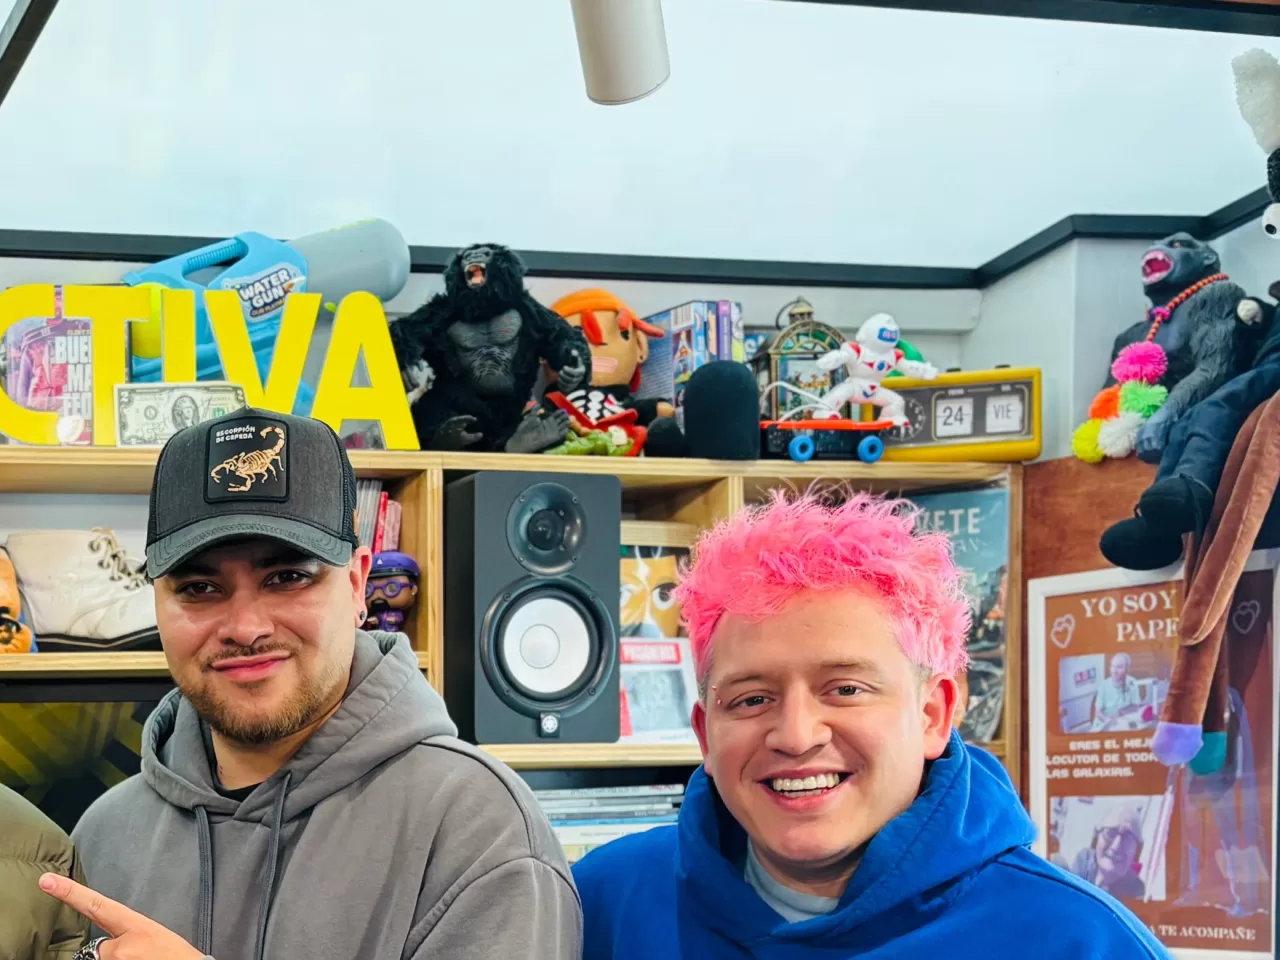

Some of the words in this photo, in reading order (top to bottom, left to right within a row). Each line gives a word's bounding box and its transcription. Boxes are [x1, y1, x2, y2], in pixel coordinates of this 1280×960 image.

[239, 268, 290, 301] WATER
[251, 284, 285, 309] GUN
[942, 405, 965, 427] 24
[993, 402, 1013, 419] VIE
[216, 434, 224, 443] DE
[1080, 597, 1117, 618] YO
[1123, 588, 1177, 613] SOY
[1069, 740, 1101, 751] ERES
[1104, 739, 1119, 749] EL
[1044, 753, 1100, 765] LOCUTOR
[1103, 753, 1120, 763] DE
[1045, 768, 1070, 778] LAS
[1072, 766, 1134, 778] GALAXIAS.
[1160, 924, 1177, 937] TE
[1180, 926, 1257, 941] ACOMPAÑE
